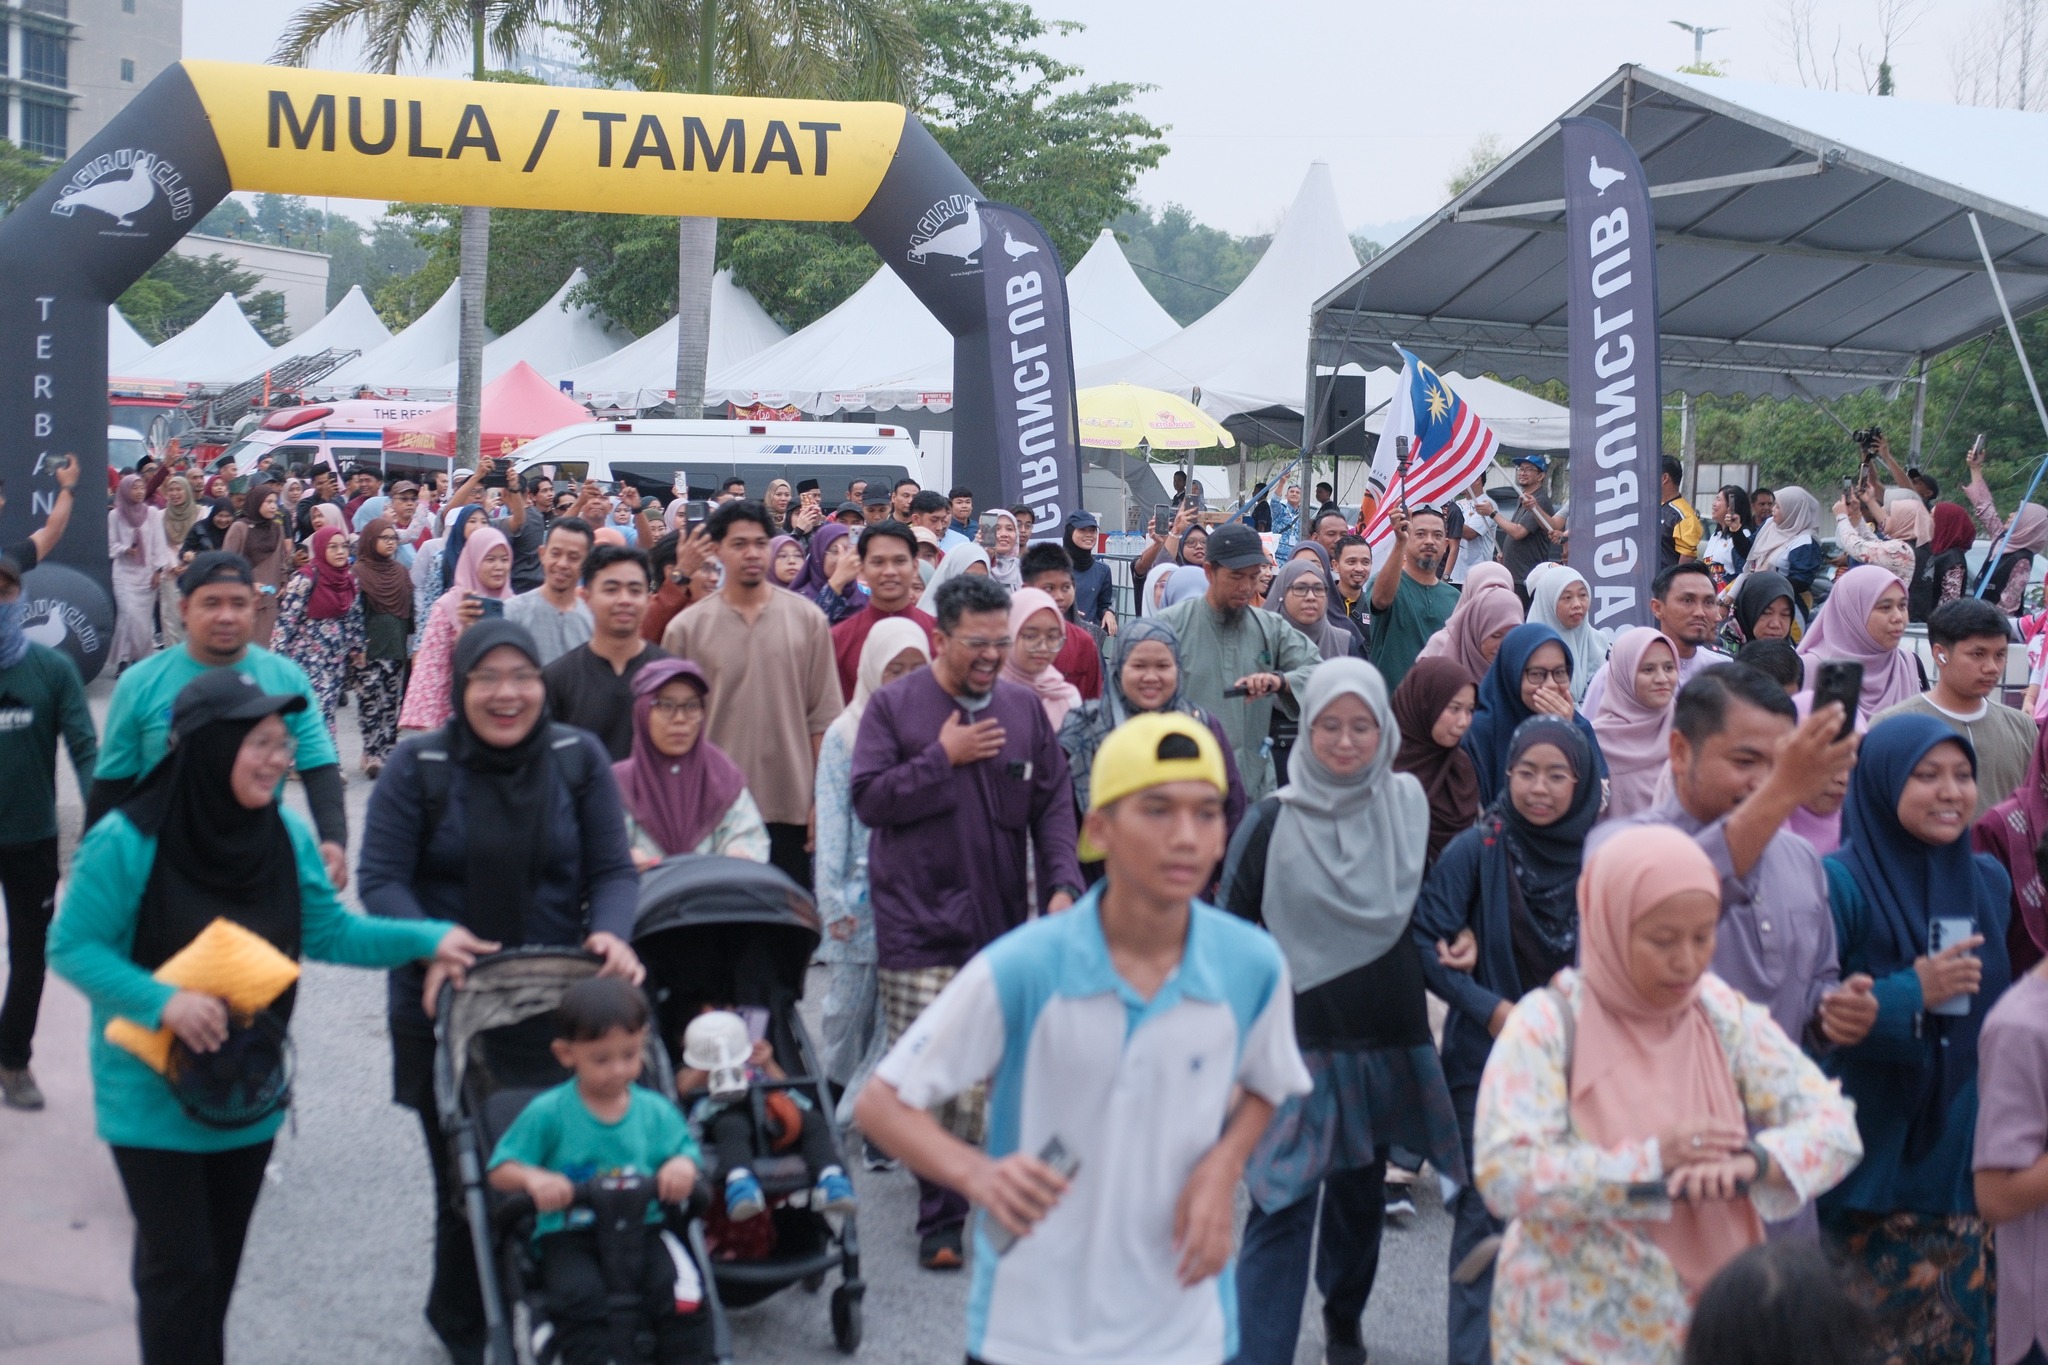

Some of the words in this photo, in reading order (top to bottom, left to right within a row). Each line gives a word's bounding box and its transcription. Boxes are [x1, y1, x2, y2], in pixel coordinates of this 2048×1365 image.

[268, 90, 502, 162] MULA
[522, 109, 560, 173] /
[582, 111, 842, 176] TAMAT
[373, 408, 398, 420] THE
[791, 445, 855, 455] AMBULANS
